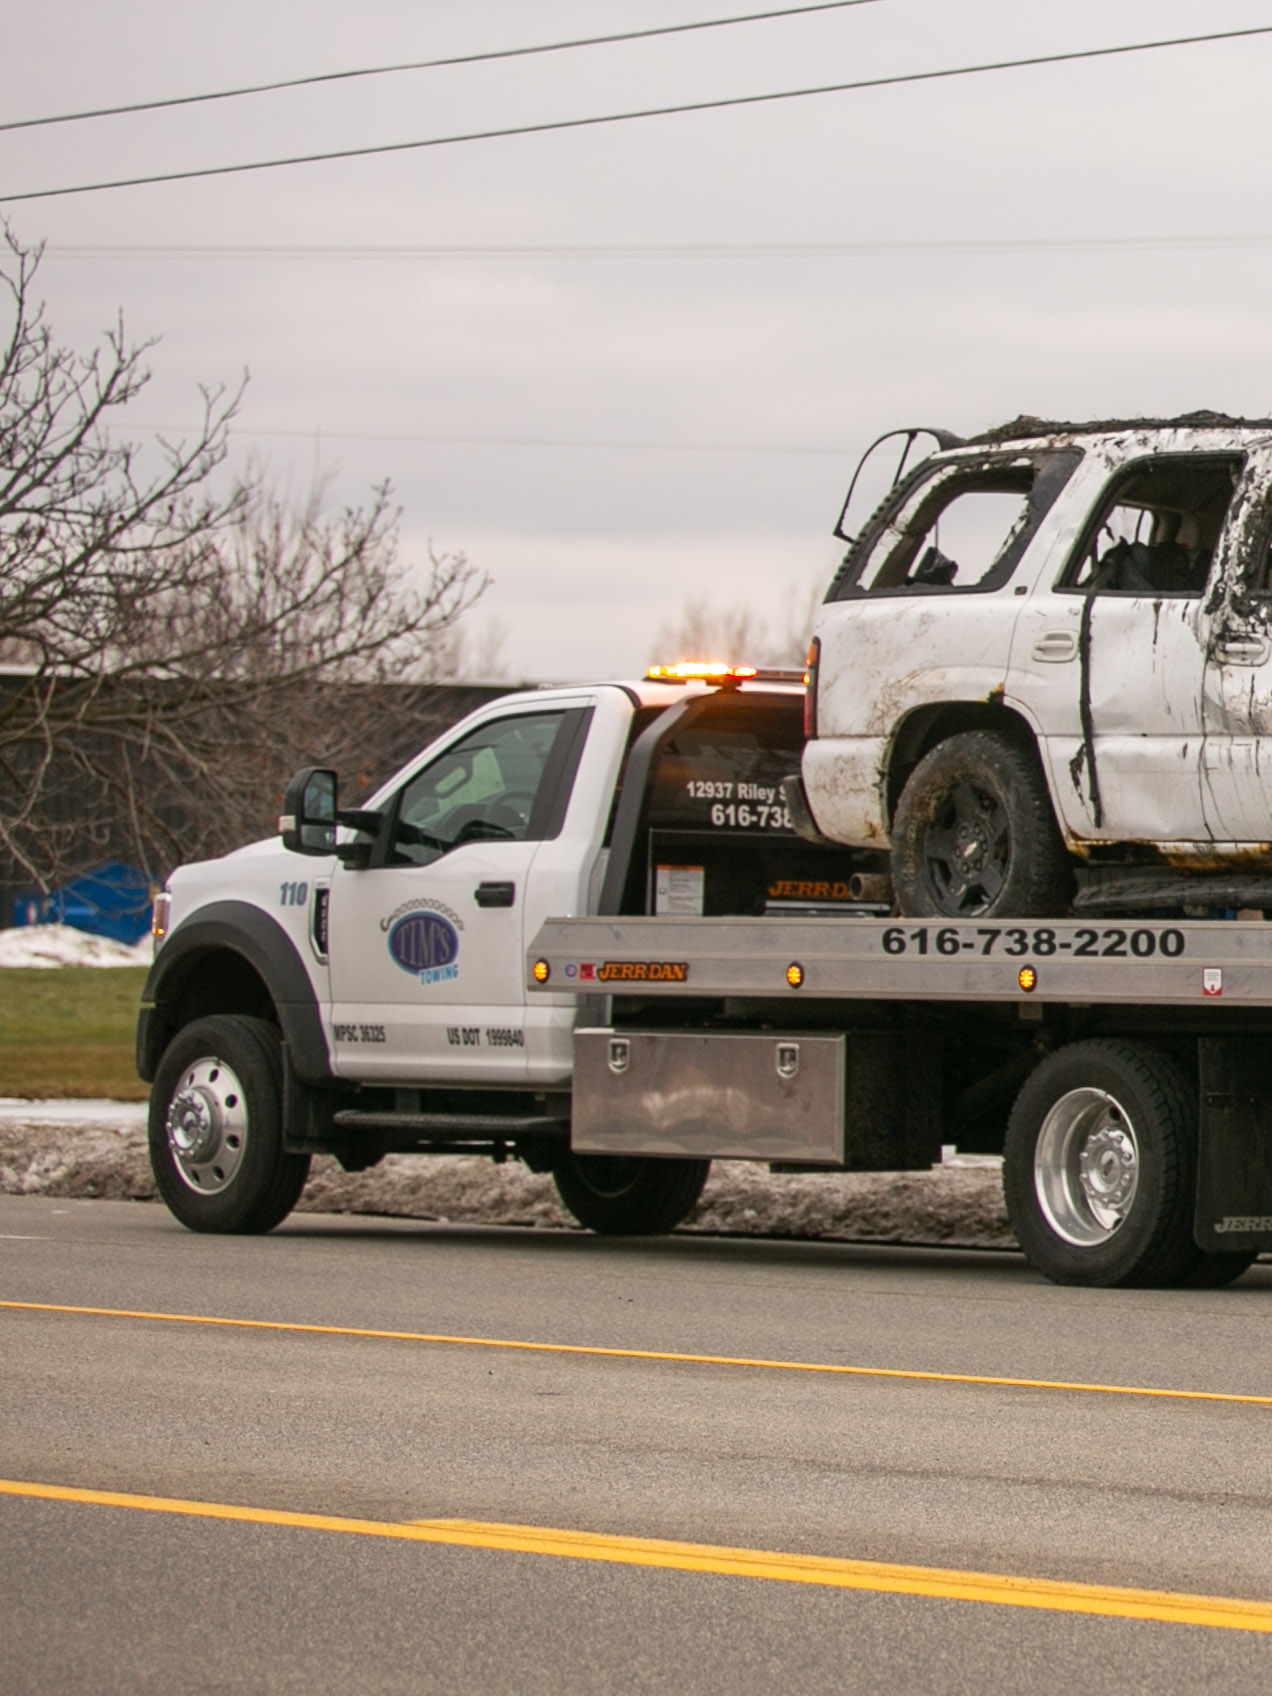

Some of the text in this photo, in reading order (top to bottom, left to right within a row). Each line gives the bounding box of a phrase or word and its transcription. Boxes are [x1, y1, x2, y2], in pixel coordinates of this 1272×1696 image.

[686, 780, 734, 799] 12937
[737, 783, 775, 804] Riley
[280, 881, 308, 906] 110
[768, 880, 851, 898] JERR-D
[881, 927, 1186, 958] 616-738-2200
[418, 964, 460, 986] TOWING
[333, 1024, 387, 1044] MPSC 36325
[447, 1027, 525, 1048] US DOT 1999840
